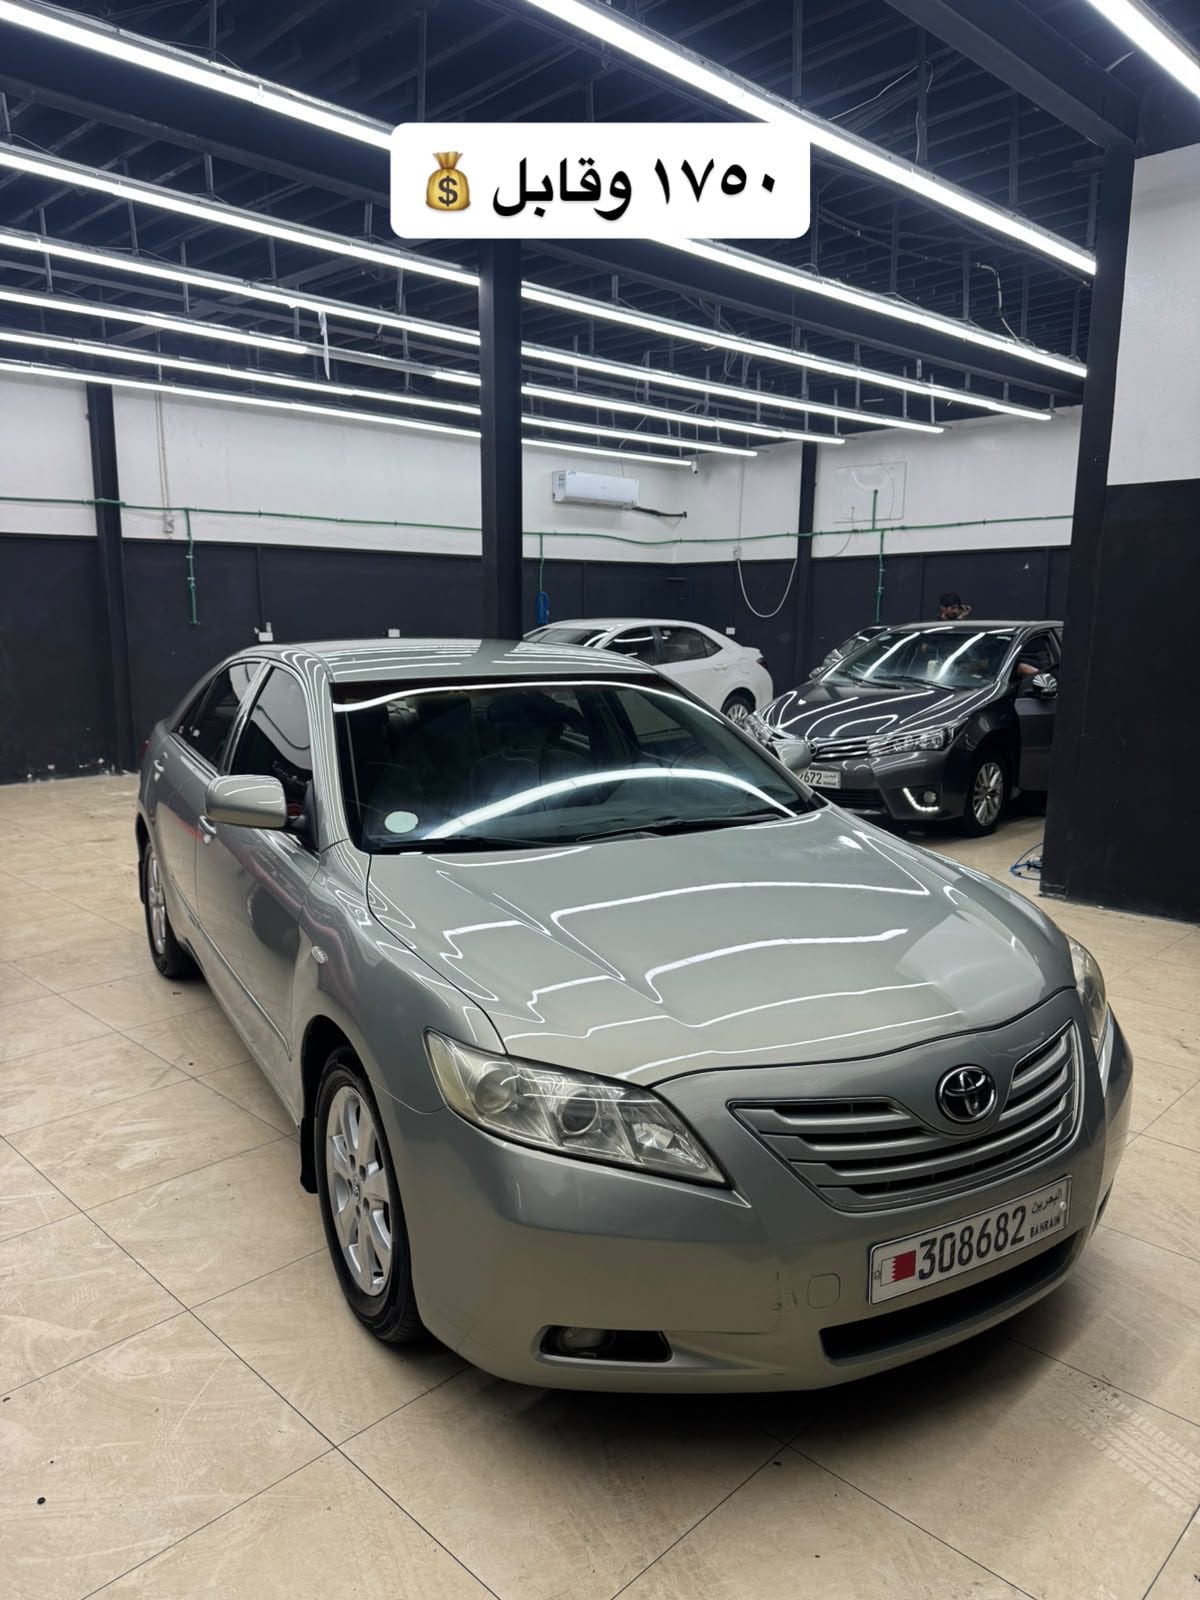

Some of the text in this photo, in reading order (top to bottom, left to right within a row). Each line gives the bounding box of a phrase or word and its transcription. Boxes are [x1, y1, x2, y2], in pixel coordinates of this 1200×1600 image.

[800, 771, 822, 785] 672
[1029, 1214, 1061, 1239] BAHRAIN
[918, 1205, 1027, 1280] 308682
